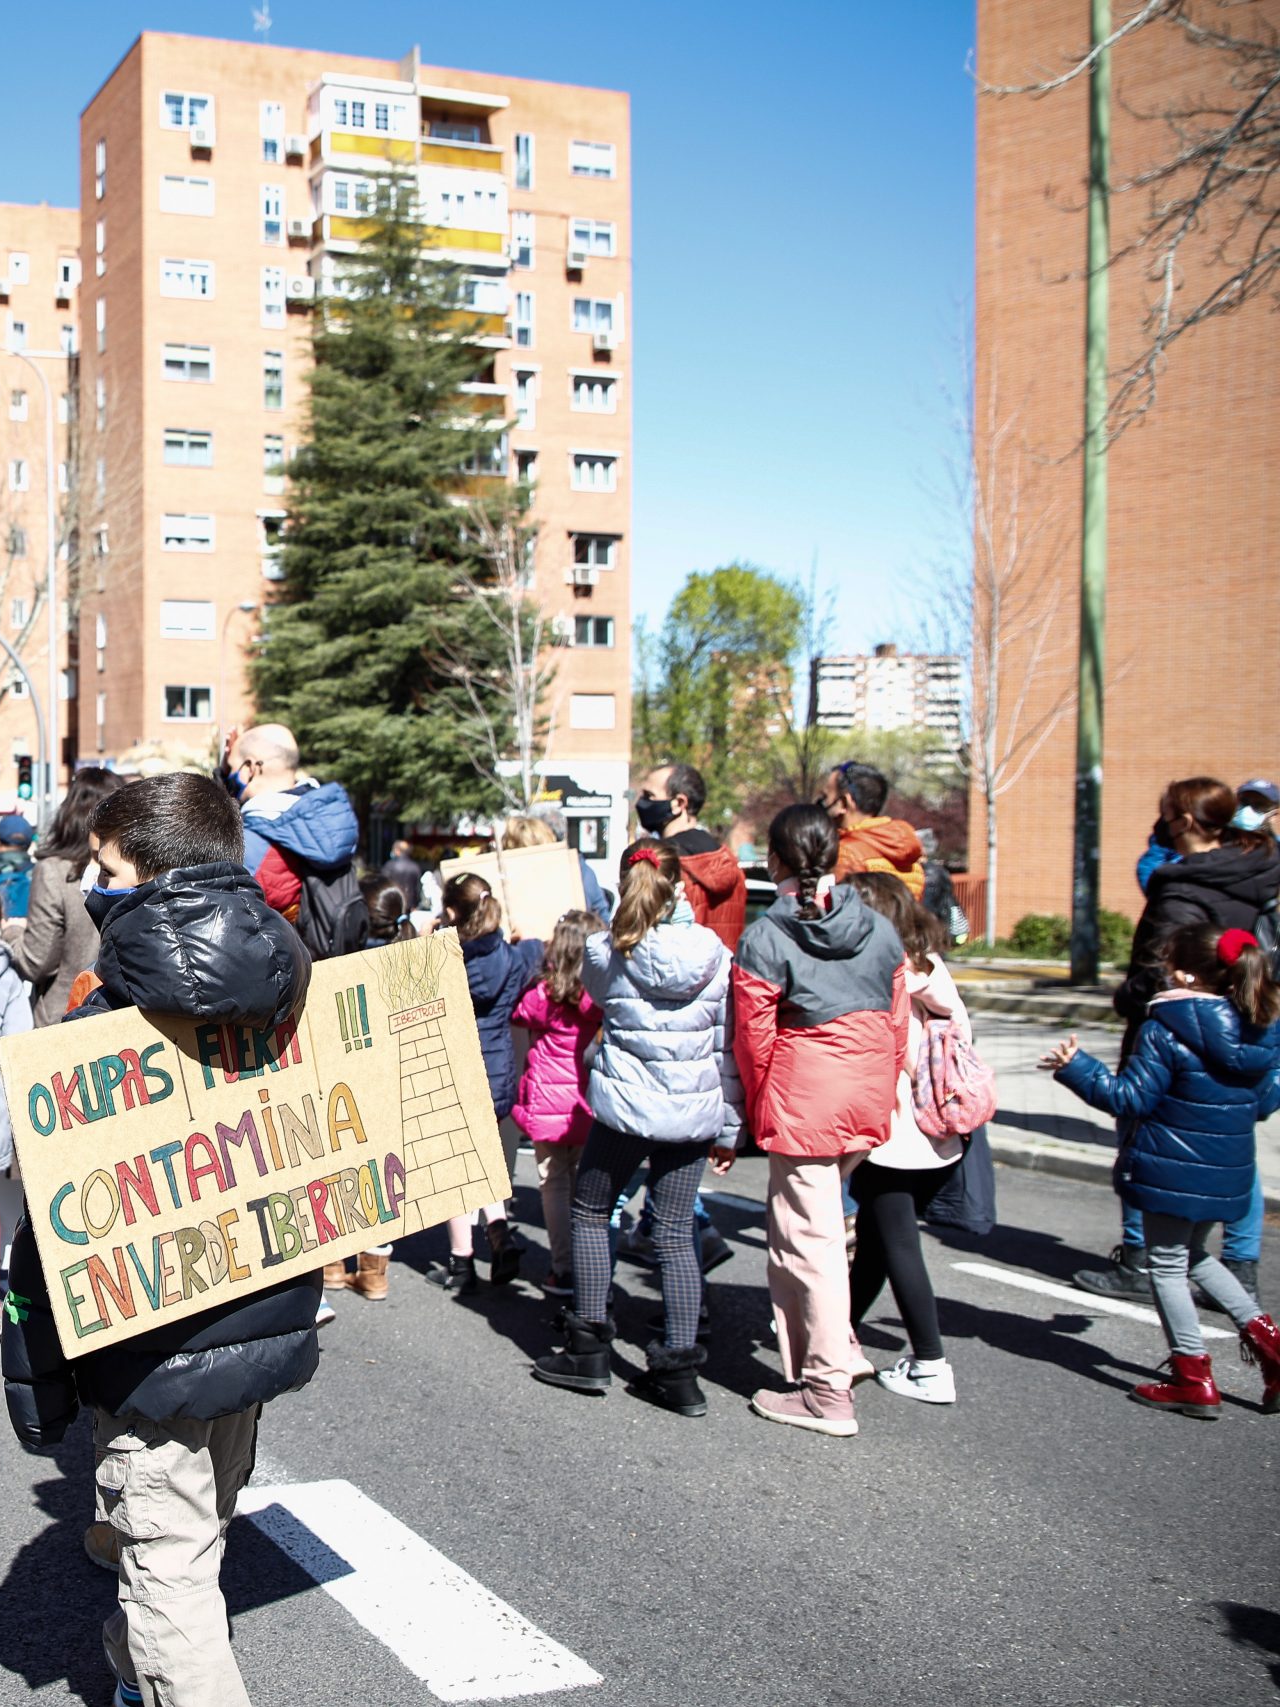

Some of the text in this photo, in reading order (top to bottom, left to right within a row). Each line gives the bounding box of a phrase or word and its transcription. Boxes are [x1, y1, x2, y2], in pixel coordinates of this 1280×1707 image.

[393, 1002, 444, 1028] IBERTROLA
[28, 1042, 174, 1137] OKUPAS
[246, 1152, 406, 1269] IBERTROLA
